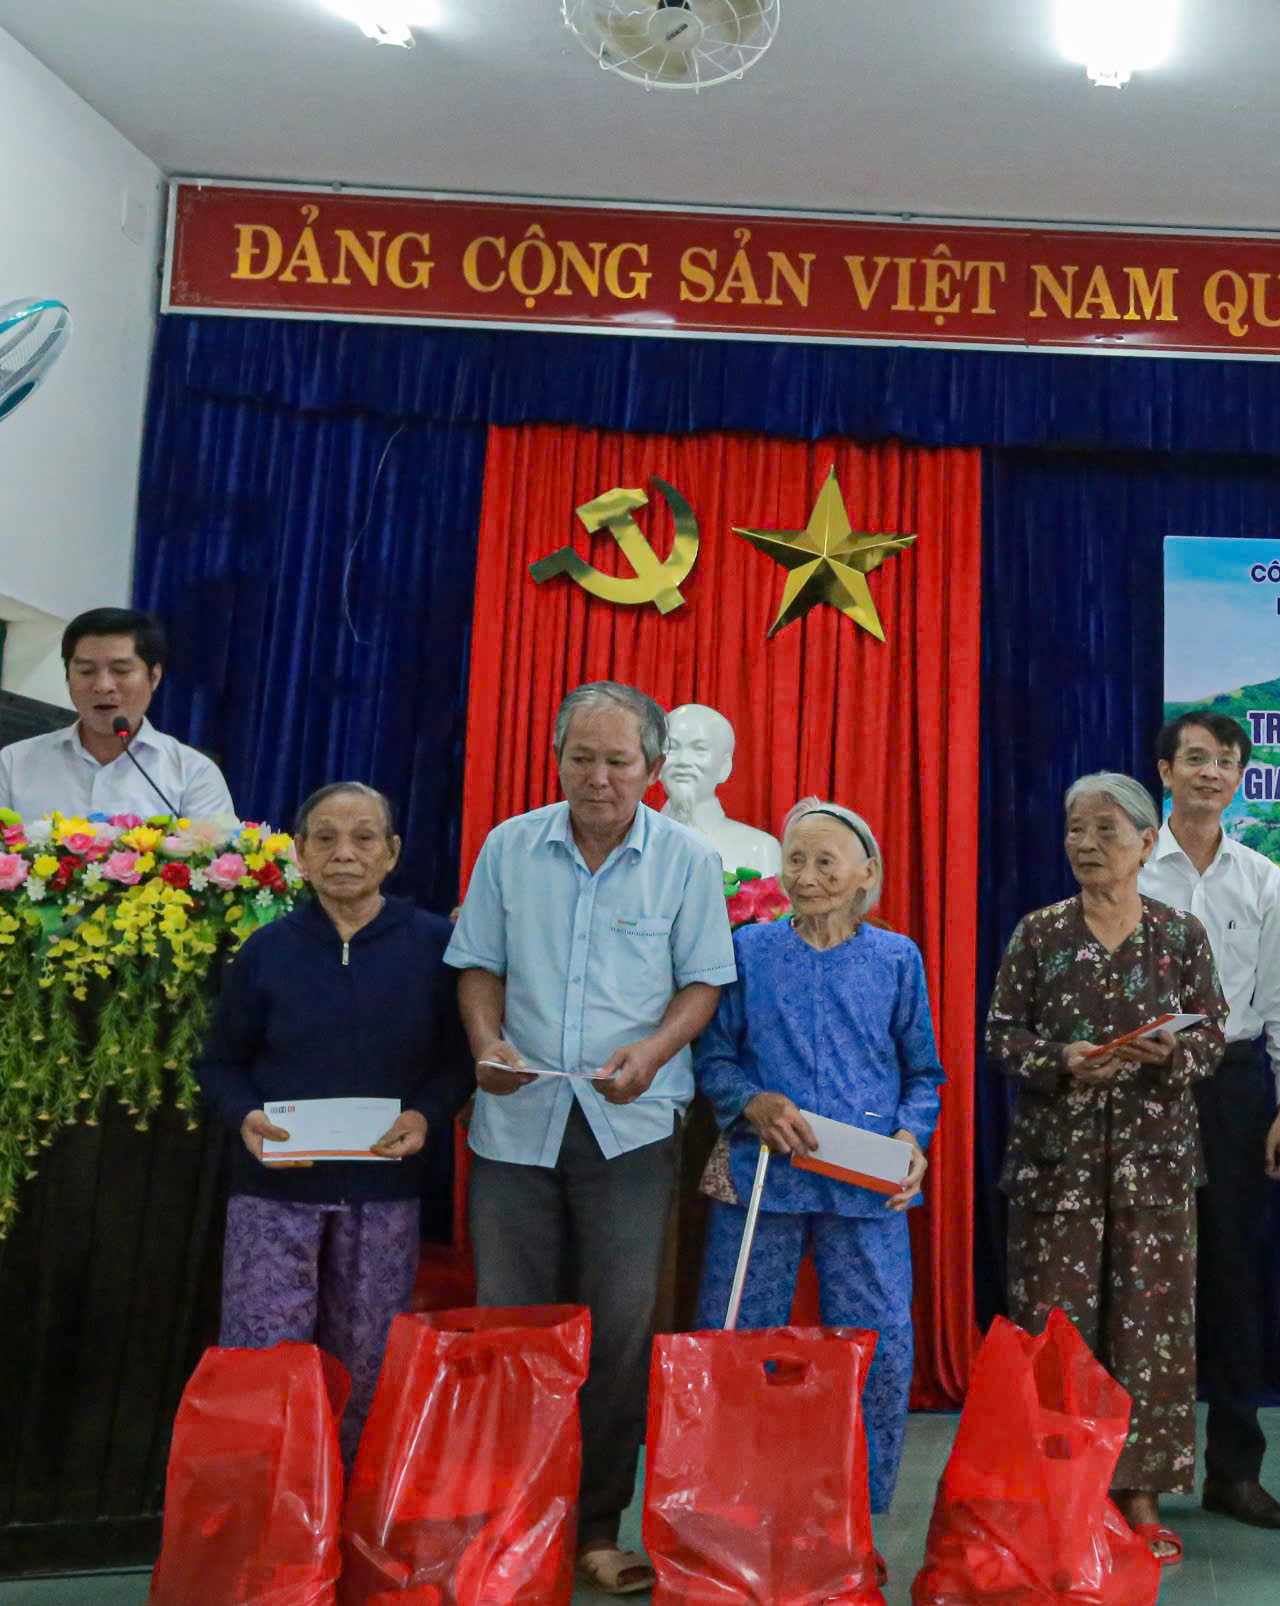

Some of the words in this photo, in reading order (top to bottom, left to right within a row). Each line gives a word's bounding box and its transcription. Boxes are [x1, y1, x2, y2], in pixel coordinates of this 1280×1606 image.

[230, 204, 435, 290] ĐẢNG
[462, 223, 652, 309] CỘNG
[680, 228, 816, 307] SẢN
[844, 243, 1006, 326] VIỆT
[1029, 265, 1179, 321] NAM
